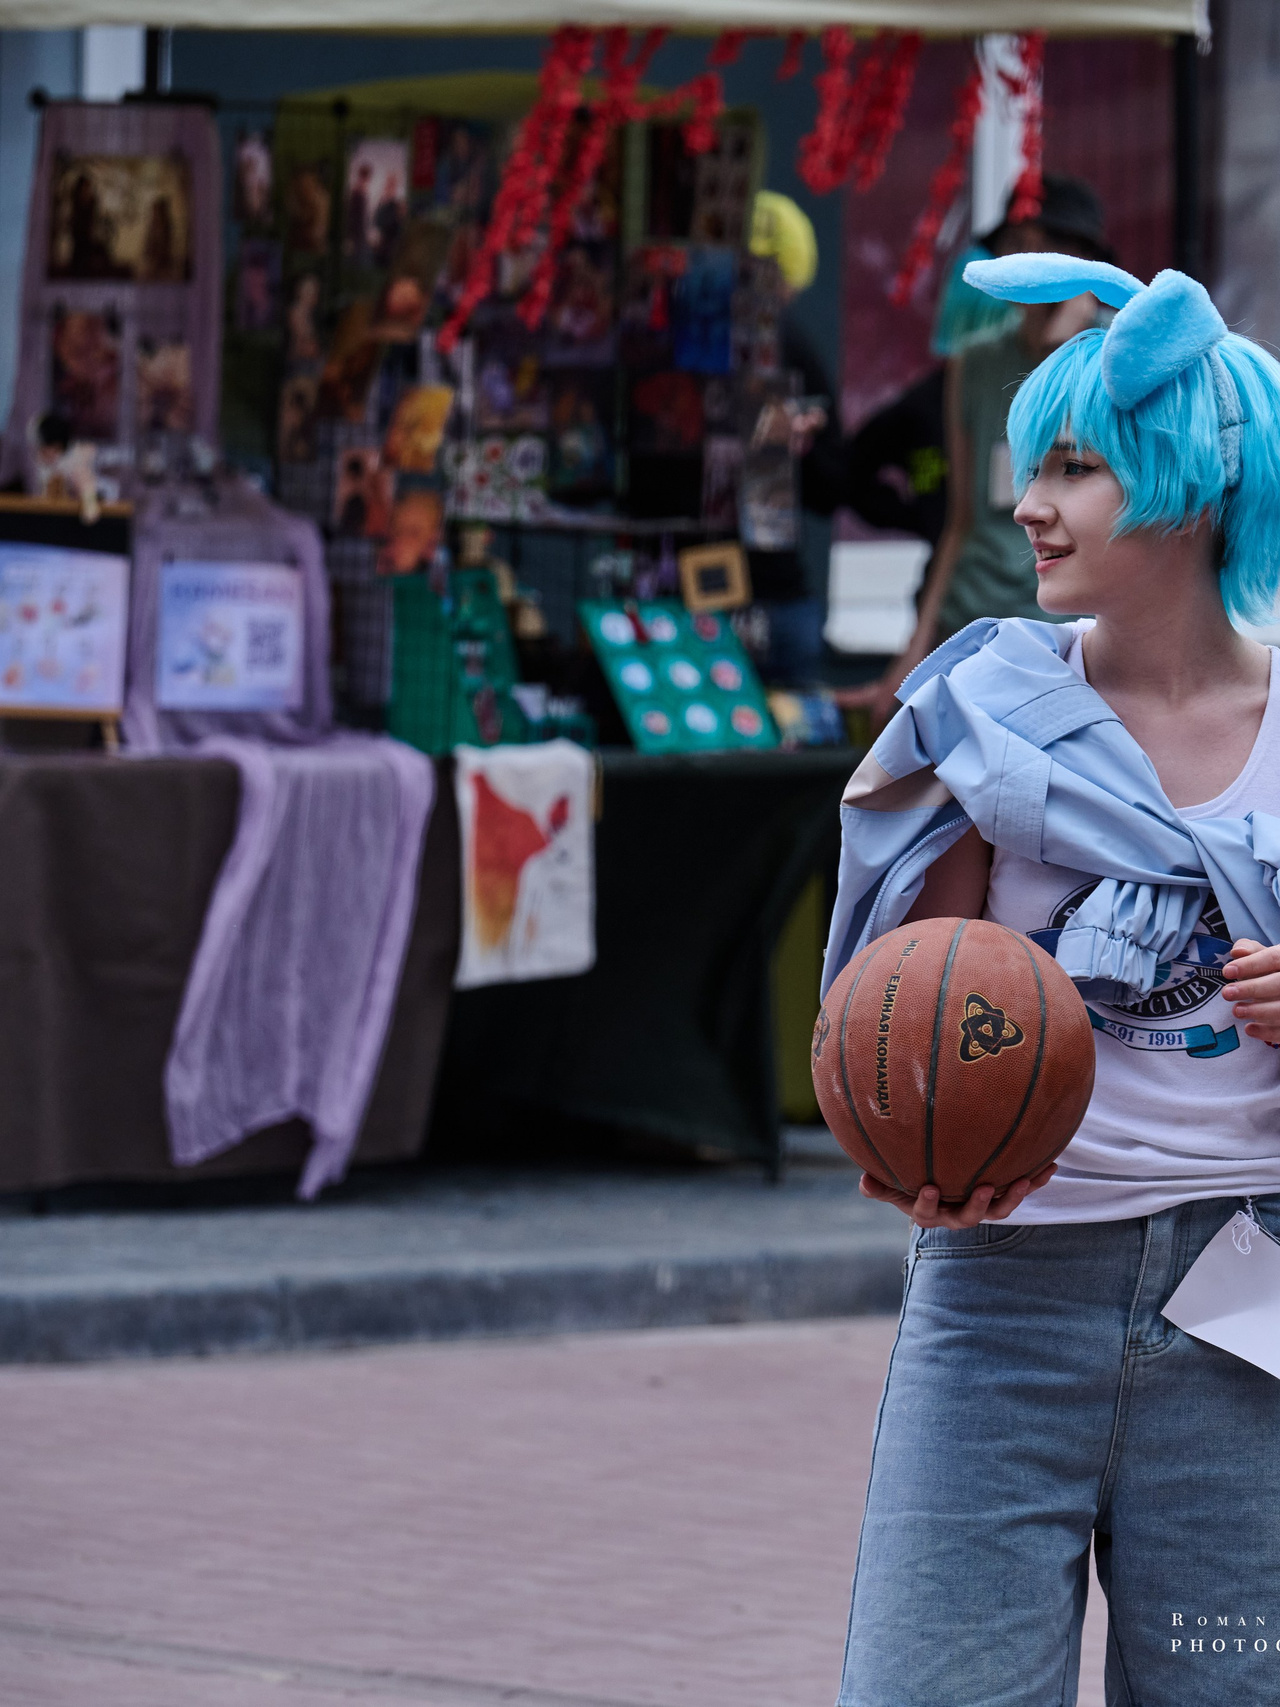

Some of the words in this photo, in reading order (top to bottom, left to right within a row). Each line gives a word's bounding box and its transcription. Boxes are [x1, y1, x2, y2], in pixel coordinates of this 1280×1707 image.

[901, 938, 921, 957] МЫ
[879, 974, 902, 1033] ЕДИНАЯ
[1149, 1032, 1184, 1046] 1991
